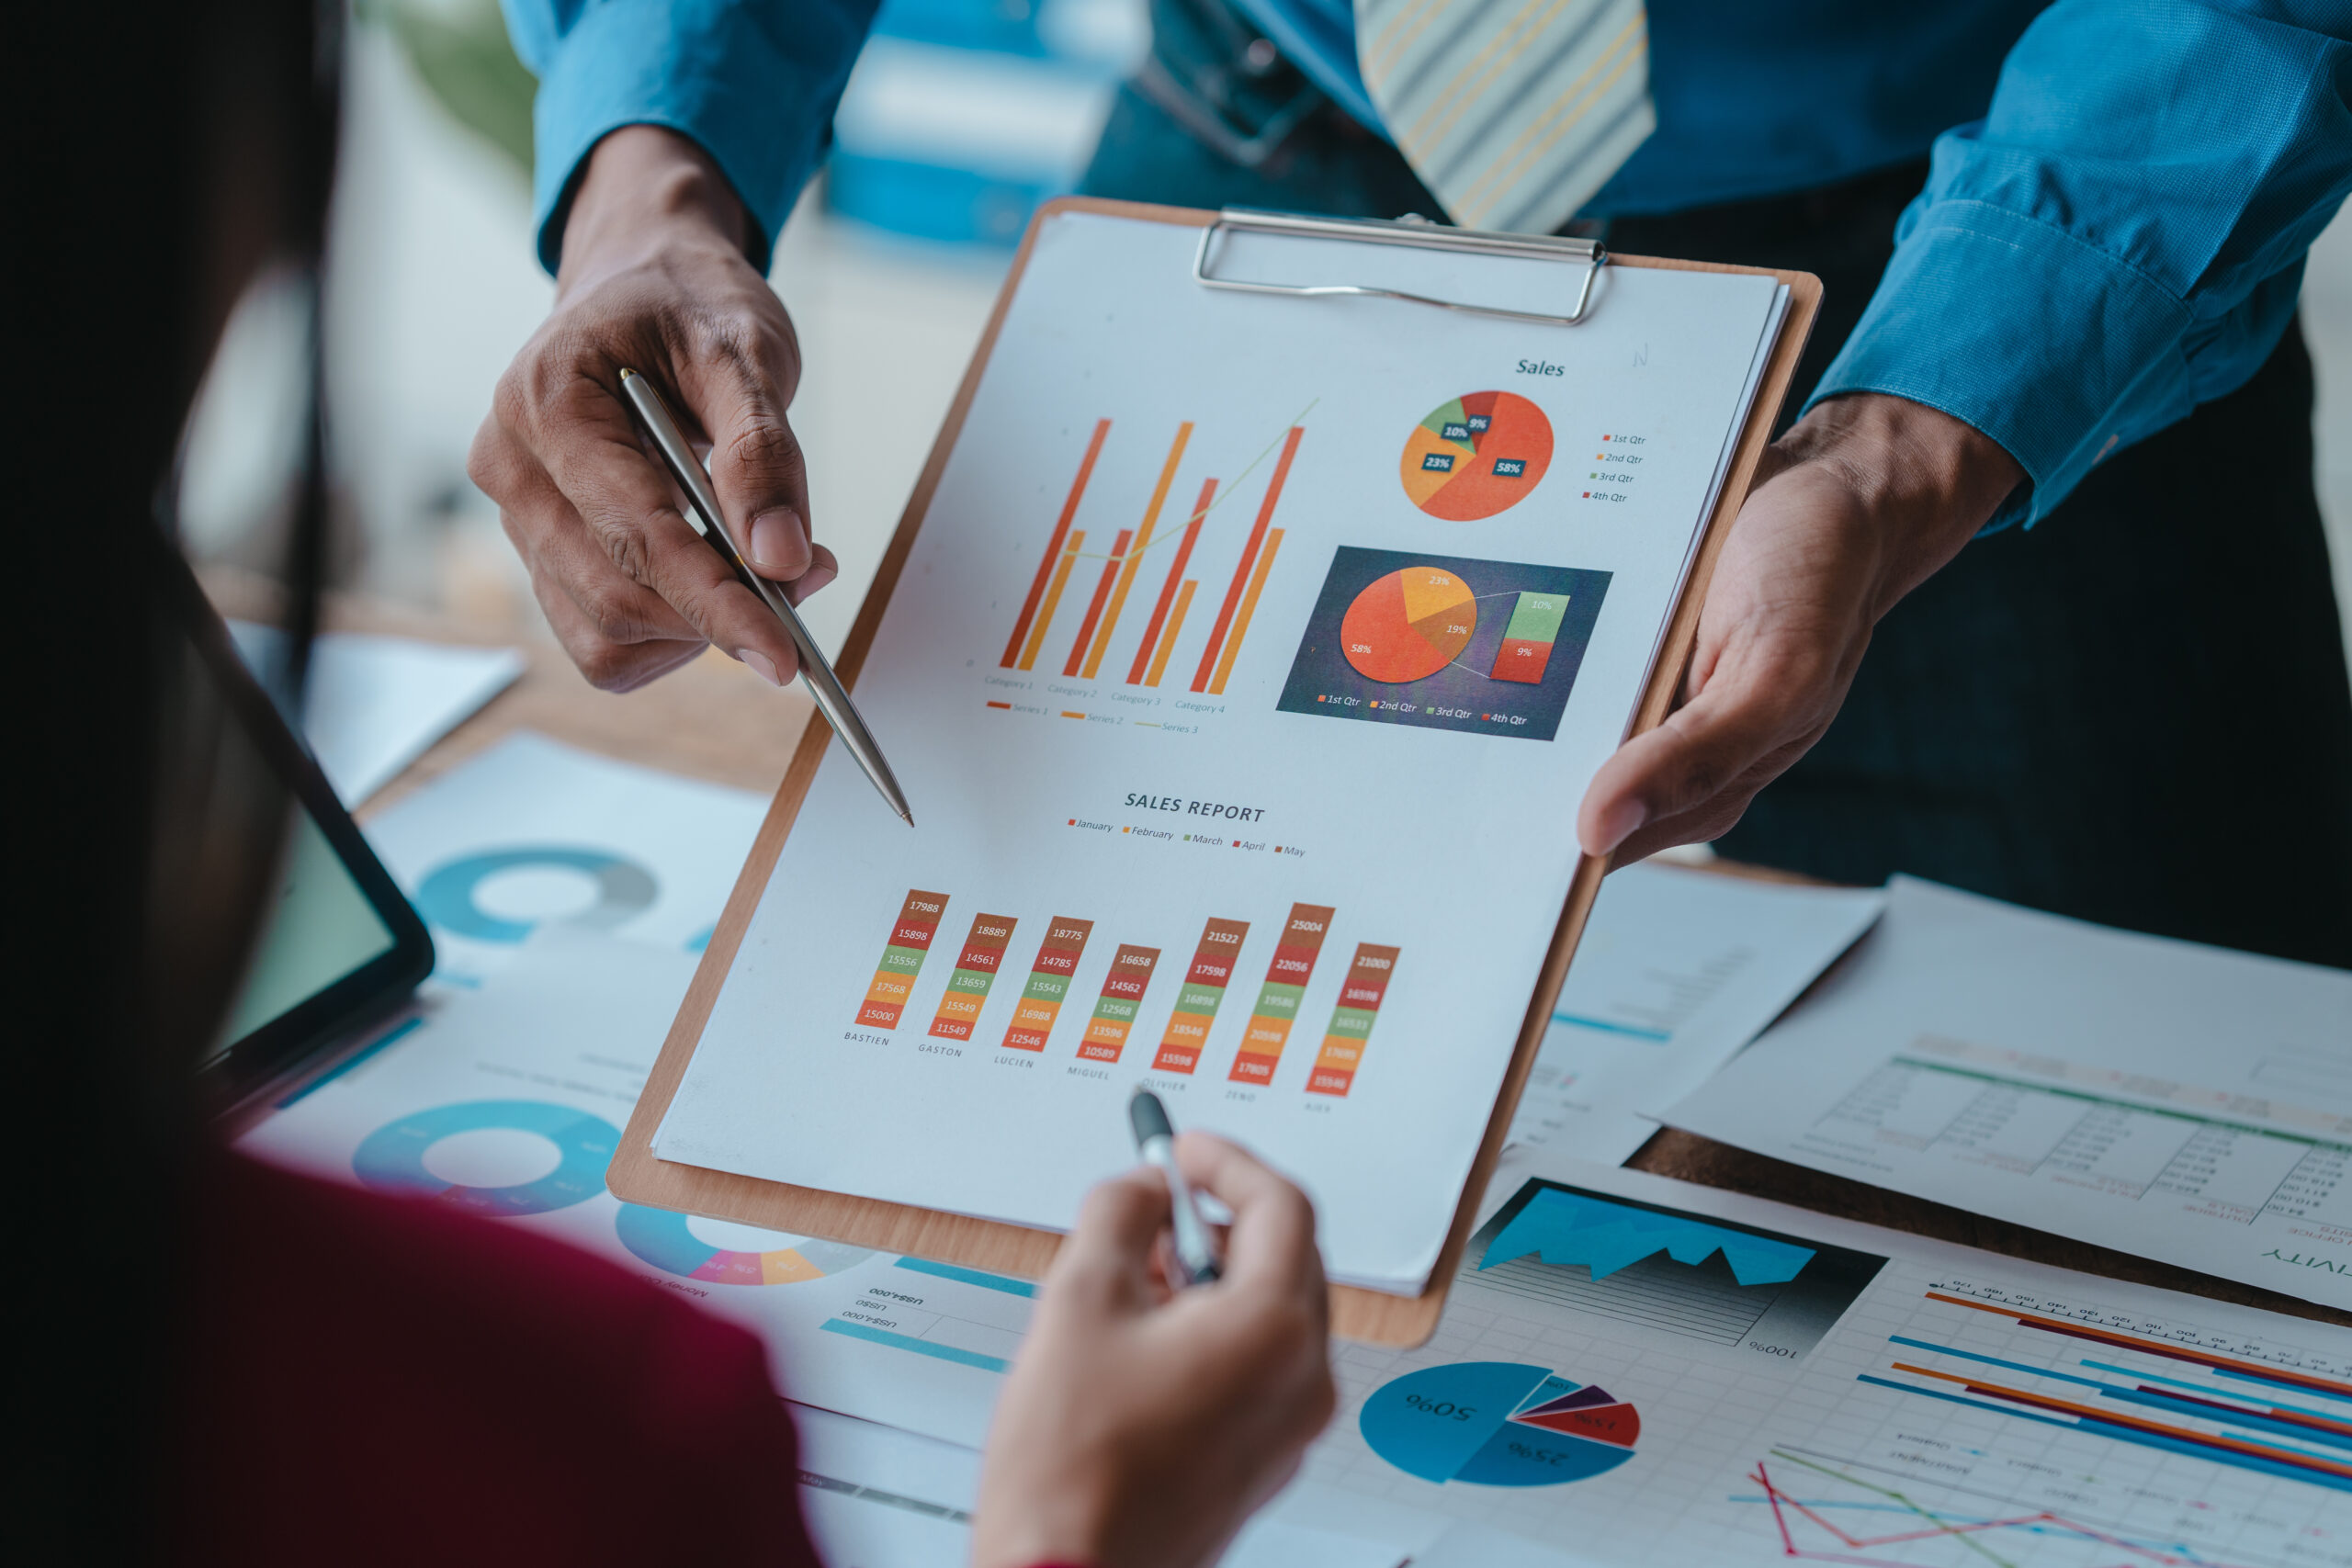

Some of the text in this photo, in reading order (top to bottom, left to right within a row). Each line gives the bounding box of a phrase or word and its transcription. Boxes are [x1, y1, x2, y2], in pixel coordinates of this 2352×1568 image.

[1515, 358, 1566, 377] Sales
[1468, 417, 1487, 430] 9%
[1444, 425, 1468, 438] 10%
[1612, 434, 1646, 446] 1st Qtr
[1426, 457, 1450, 469] 23%
[1605, 453, 1644, 465] 2nd Qtr
[1497, 461, 1521, 474] 58%
[1599, 471, 1634, 484] 3rd Qtr
[1592, 491, 1627, 504] 4th Qtr
[1429, 575, 1450, 586] 23%
[1531, 599, 1553, 611] 10%
[1446, 624, 1467, 635] 19%
[1351, 643, 1372, 654] 58%
[1517, 647, 1532, 657] 9%
[984, 674, 1034, 691] Category 1
[1047, 682, 1098, 698] Category 2
[1111, 691, 1161, 706] Category 3
[1327, 694, 1361, 707] 1st Qtr
[1012, 703, 1041, 715] Series
[1175, 699, 1226, 715] Category 4
[1379, 700, 1418, 714] 2nd Qtr
[1435, 705, 1472, 720] 3rd Qtr
[1087, 712, 1124, 725] Series 2
[1491, 712, 1528, 727] 4th Qtr
[1161, 721, 1198, 734] Series 3
[1125, 793, 1265, 823] SALES REPORT
[1076, 818, 1114, 833] January
[1131, 826, 1174, 841] February
[1193, 834, 1223, 846] March
[1241, 840, 1266, 852] April
[1283, 845, 1306, 858] May
[910, 900, 940, 913] 17988
[977, 925, 1007, 938] 18889
[1291, 919, 1323, 933] 25004
[898, 929, 928, 941] 15898
[1052, 928, 1083, 941] 18775
[1207, 931, 1239, 944] 21522
[888, 954, 918, 967] 15556
[965, 953, 995, 965] 14561
[1041, 955, 1071, 968] 14785
[1120, 954, 1151, 967] 16658
[1194, 964, 1227, 977] 17598
[1275, 959, 1308, 973] 22056
[876, 982, 907, 995] 17568
[956, 976, 986, 989] 13659
[1031, 981, 1062, 994] 15543
[1109, 980, 1141, 994] 14562
[946, 1000, 977, 1013] 15549
[1102, 1004, 1132, 1017] 12568
[864, 1009, 895, 1021] 15000
[1021, 1009, 1052, 1021] 16988
[935, 1022, 967, 1035] 11549
[1091, 1026, 1123, 1039] 13596
[843, 1032, 890, 1046] BASTIEN
[1011, 1033, 1041, 1046] 12546
[918, 1043, 963, 1057] GASTON
[1084, 1045, 1115, 1059] 10589
[994, 1055, 1035, 1068] LUCIEN
[1067, 1066, 1110, 1081] MIGUEL
[1141, 1077, 1187, 1092] OLIVIER
[2287, 1227, 2344, 1245] OFFICE
[665, 1280, 708, 1299] Money
[1952, 1280, 1972, 1289] 170
[868, 1287, 924, 1306] US$4,000
[855, 1299, 888, 1313] US$0
[2047, 1301, 2067, 1310] 140
[842, 1310, 898, 1329] US$4,000
[2111, 1314, 2132, 1324] 120
[2176, 1329, 2197, 1338] 100
[1748, 1341, 1797, 1359] 100%
[1405, 1393, 1477, 1421] 50%
[1574, 1413, 1617, 1432] 15%
[1507, 1442, 1569, 1468] 25%
